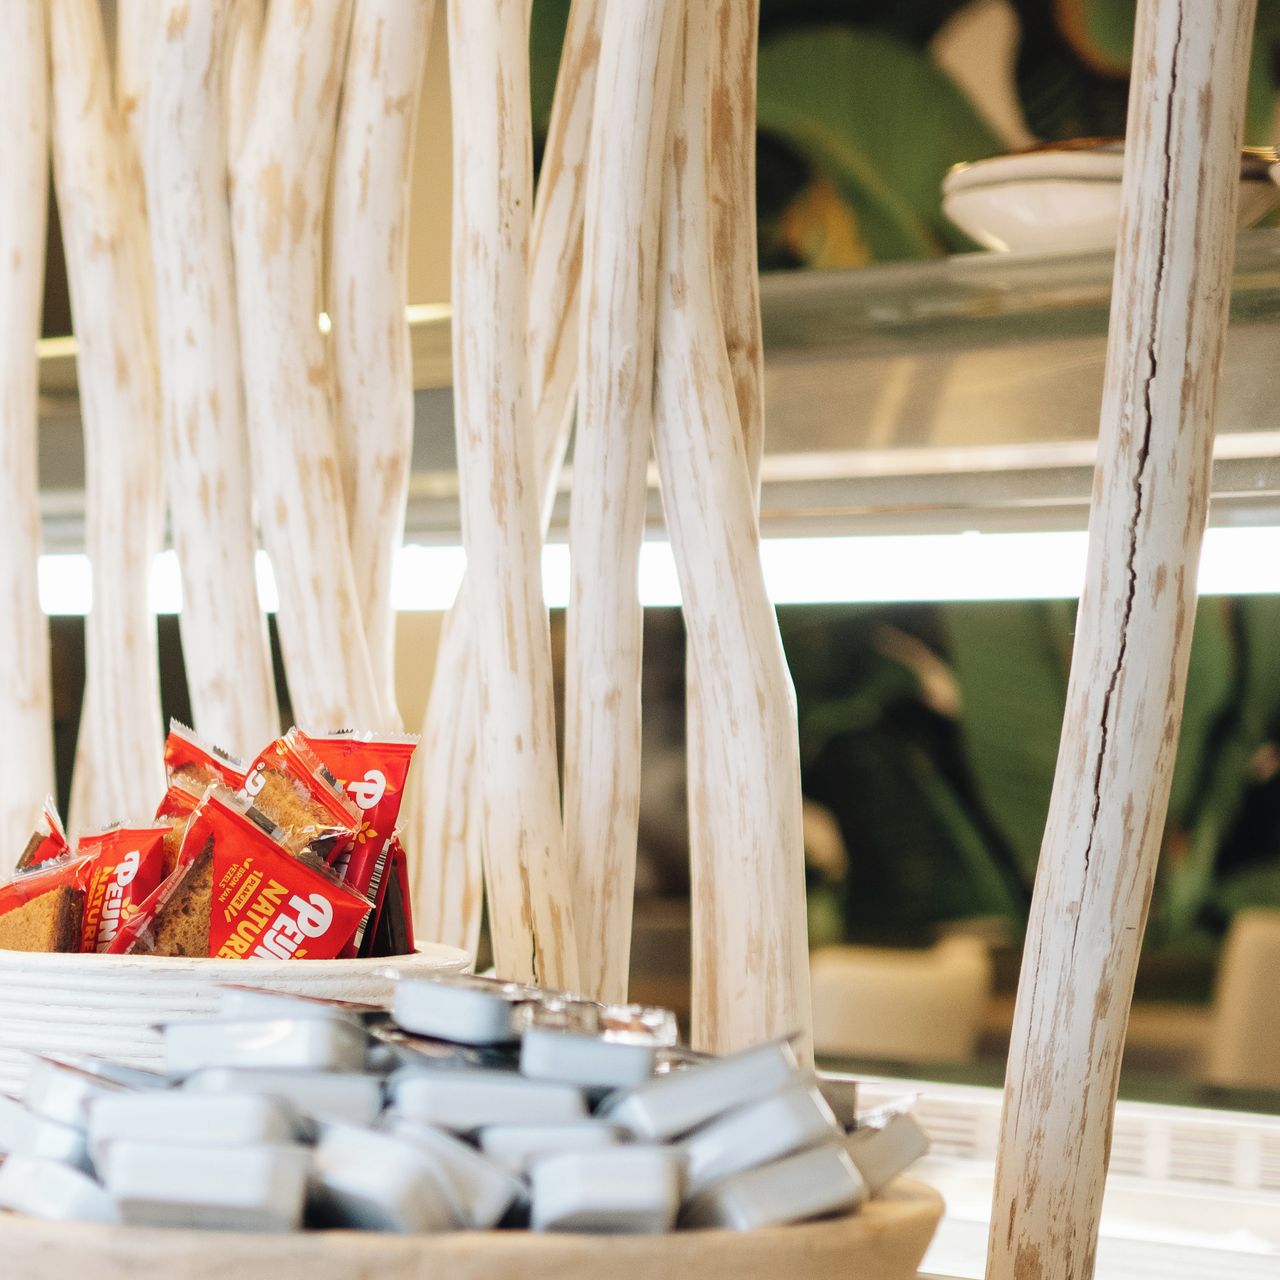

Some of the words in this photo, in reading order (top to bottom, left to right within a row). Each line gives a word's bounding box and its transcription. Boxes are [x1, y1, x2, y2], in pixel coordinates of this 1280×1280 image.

[219, 863, 239, 888] VEZELS
[228, 868, 246, 888] BRON
[219, 887, 232, 903] VAN
[234, 878, 258, 907] PLAKJE
[215, 879, 289, 959] NATURE
